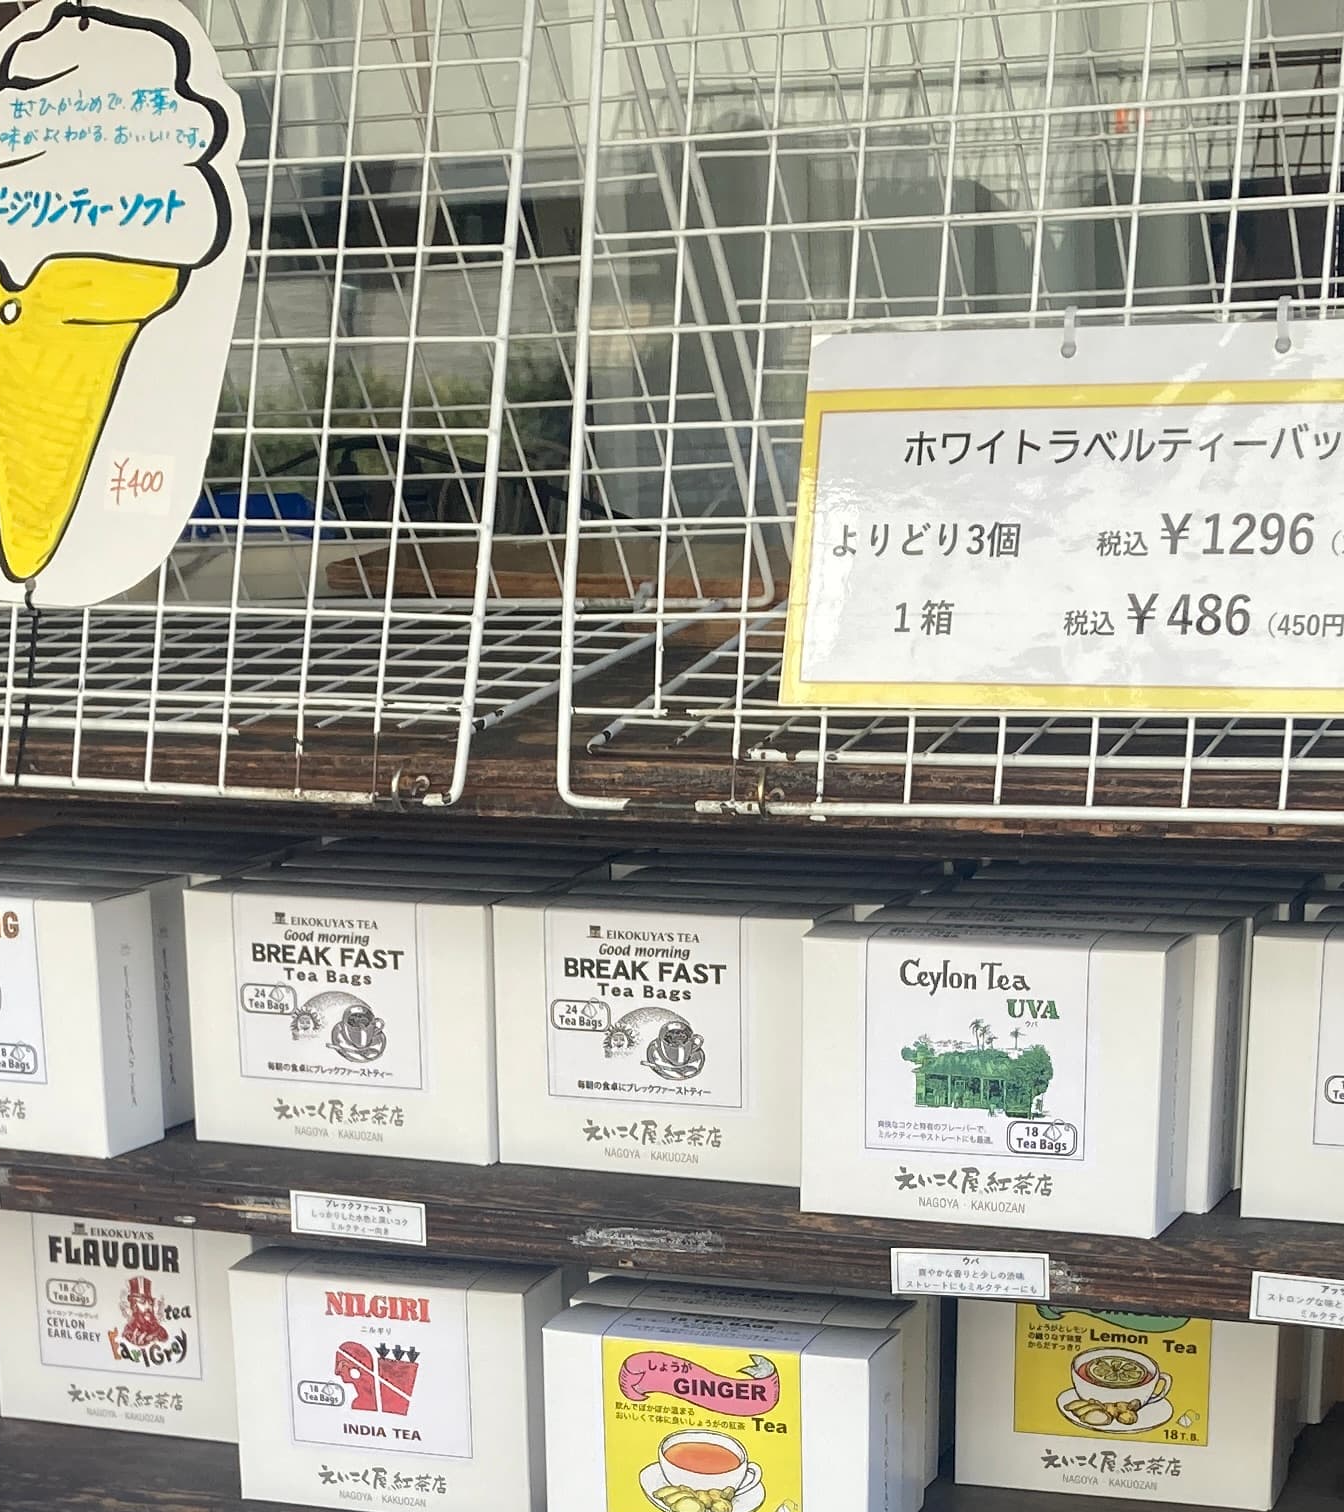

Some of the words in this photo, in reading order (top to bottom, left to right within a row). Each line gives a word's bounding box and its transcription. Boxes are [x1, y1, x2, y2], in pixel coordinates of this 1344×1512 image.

[110, 461, 164, 504] ¥400
[832, 521, 1022, 561] よりどり3個
[1096, 529, 1148, 558] 税込
[1161, 511, 1316, 558] ¥1296
[1063, 609, 1115, 638] 税込
[1127, 592, 1251, 638] ¥486
[677, 931, 700, 944] TEA
[251, 943, 336, 968] BREAK
[340, 947, 405, 971] FAST
[598, 943, 631, 959] Good
[633, 945, 690, 961] morning
[563, 957, 652, 981] BREAK
[657, 962, 727, 985] FAST
[899, 958, 976, 995] Ceylon
[979, 961, 1030, 993] Tea
[598, 983, 631, 999] Tea
[643, 985, 692, 1002] Bags
[1007, 999, 1060, 1022] UVA
[1024, 1125, 1038, 1138] 18
[1016, 1137, 1037, 1151] Tea
[1038, 1139, 1067, 1155] Bags
[918, 1196, 959, 1209] NAGOYA
[969, 1199, 1025, 1214] KAKUOZAN
[49, 1234, 180, 1274] FLAVOUR
[164, 1304, 192, 1321] tea
[324, 1290, 431, 1324] NILGIRI
[47, 1317, 85, 1330] CEYLON
[47, 1327, 73, 1341] EARL
[75, 1330, 101, 1343] GREY
[1090, 1328, 1148, 1345] Lemon
[1162, 1339, 1197, 1355] Tea
[647, 1359, 692, 1374] しょうが
[672, 1377, 768, 1404] GINGER
[343, 1422, 387, 1440] INDIA
[392, 1426, 422, 1442] TEA
[751, 1417, 788, 1435] Tea
